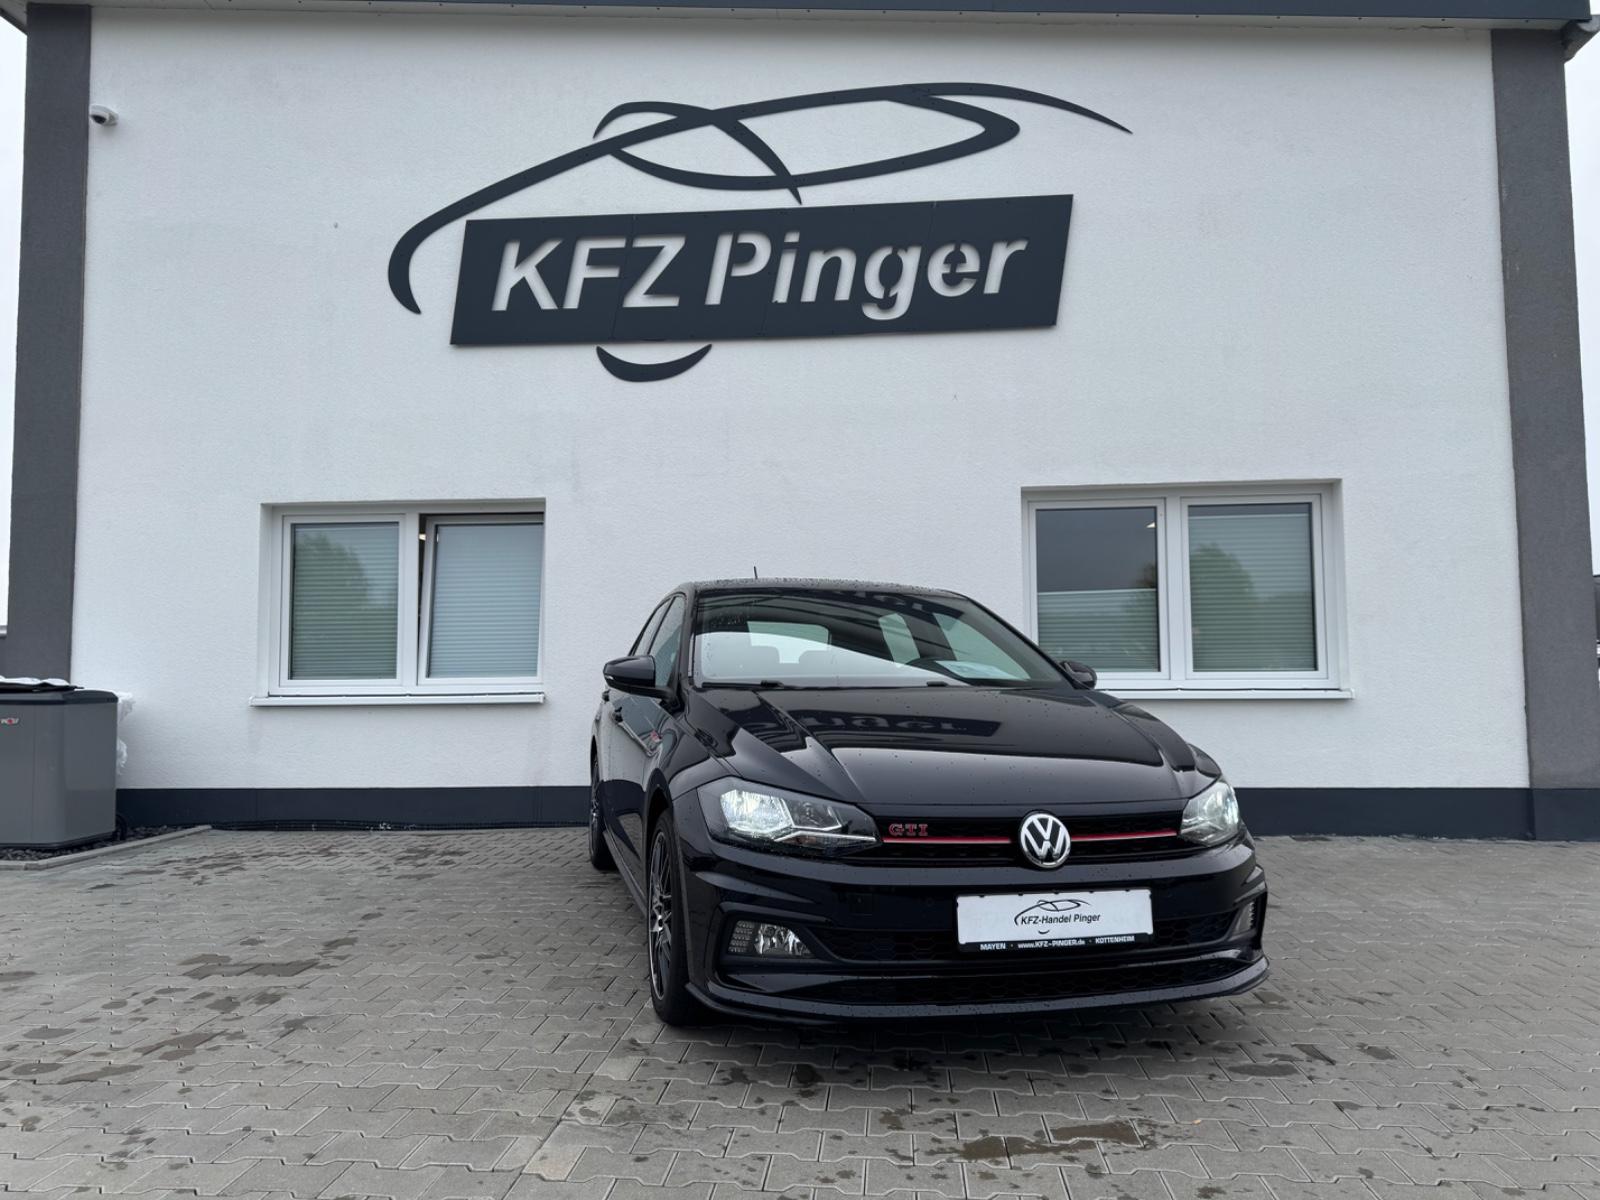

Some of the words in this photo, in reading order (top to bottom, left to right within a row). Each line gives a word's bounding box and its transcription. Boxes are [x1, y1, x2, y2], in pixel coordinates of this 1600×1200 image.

[492, 236, 686, 311] KFZ
[705, 231, 1027, 321] Pinger
[888, 823, 929, 837] GTI
[1021, 814, 1070, 867] VW
[1020, 914, 1071, 925] KFZ-Handel
[1073, 913, 1101, 924] Pinger
[979, 942, 1006, 951] MAYEN
[1017, 939, 1086, 949] www.KFZ-PINGER.de
[1095, 935, 1135, 945] KOTTENHEIM
